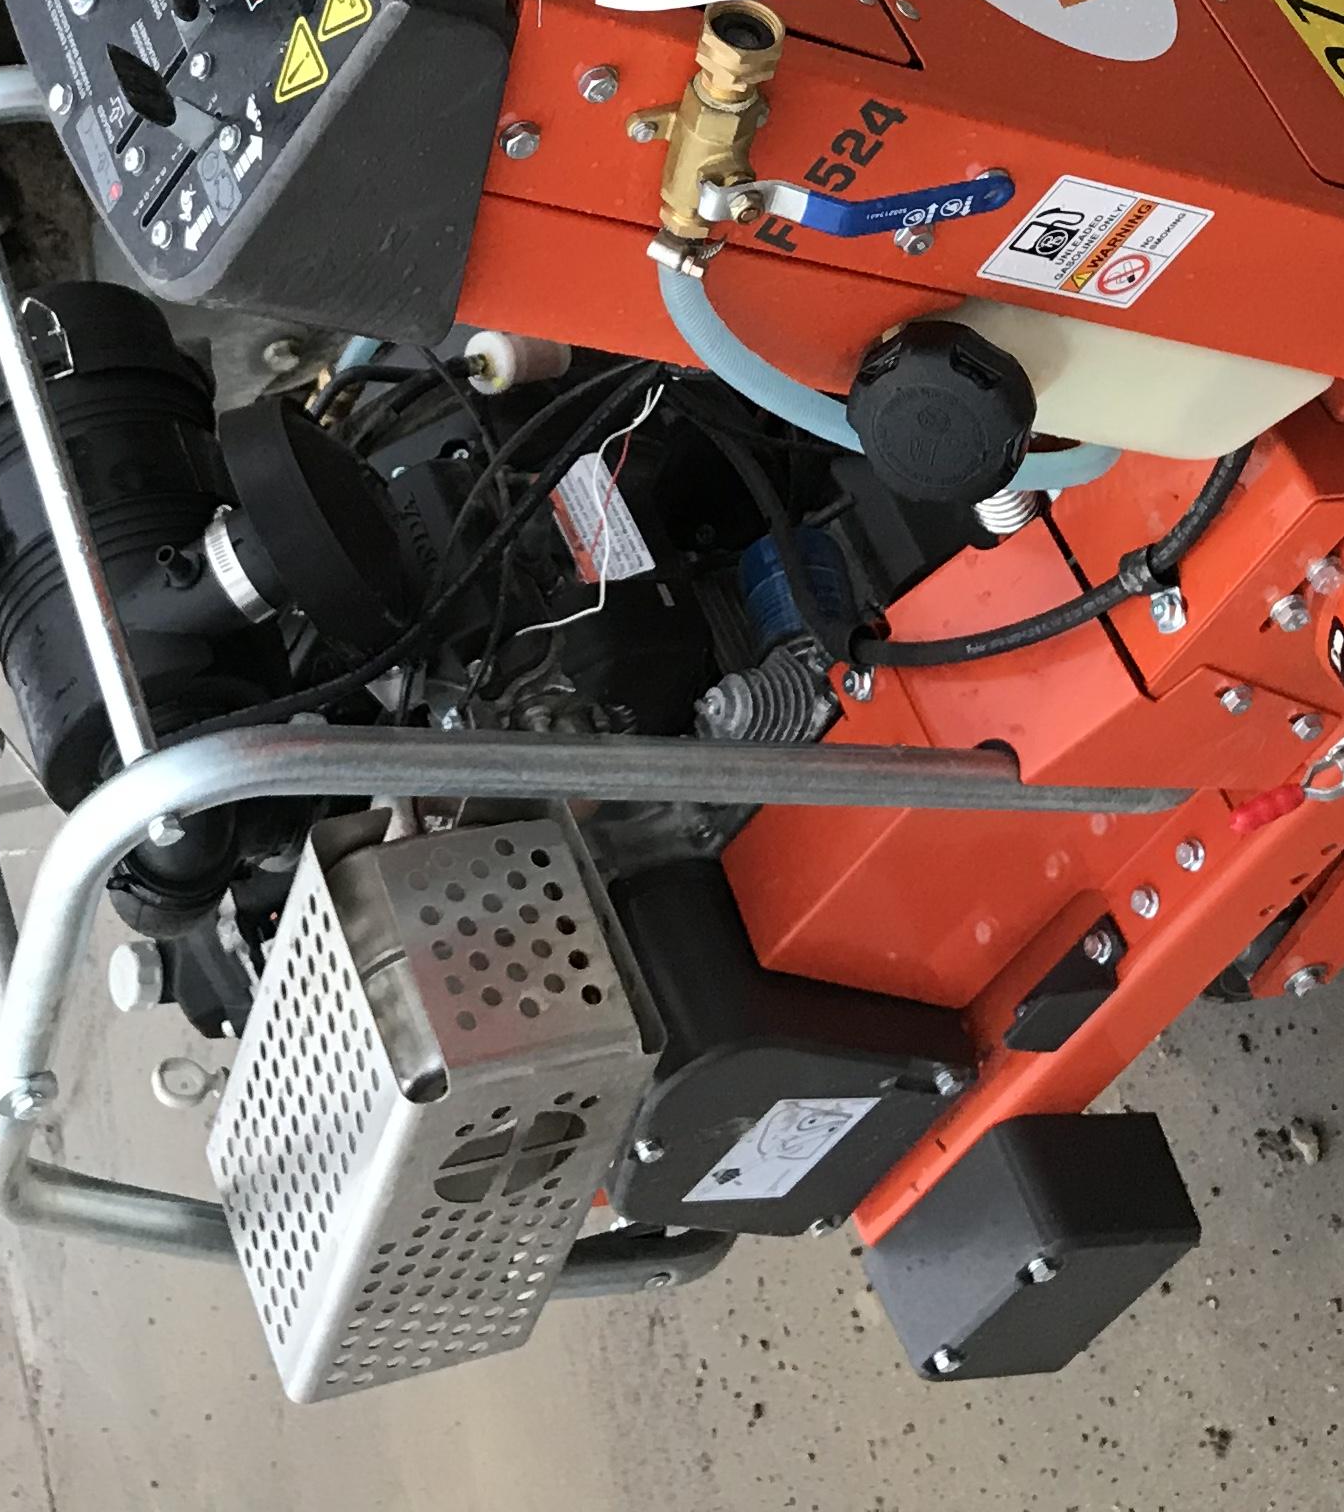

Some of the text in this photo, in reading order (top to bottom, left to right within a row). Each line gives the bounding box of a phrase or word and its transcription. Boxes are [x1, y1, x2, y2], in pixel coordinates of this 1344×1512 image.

[1051, 203, 1128, 282] GASOLINE ONLY!
[1053, 215, 1105, 267] UNLEADED
[1085, 203, 1154, 270] WARNING
[1138, 236, 1156, 249] NO
[1146, 213, 1187, 251] SMOKING
